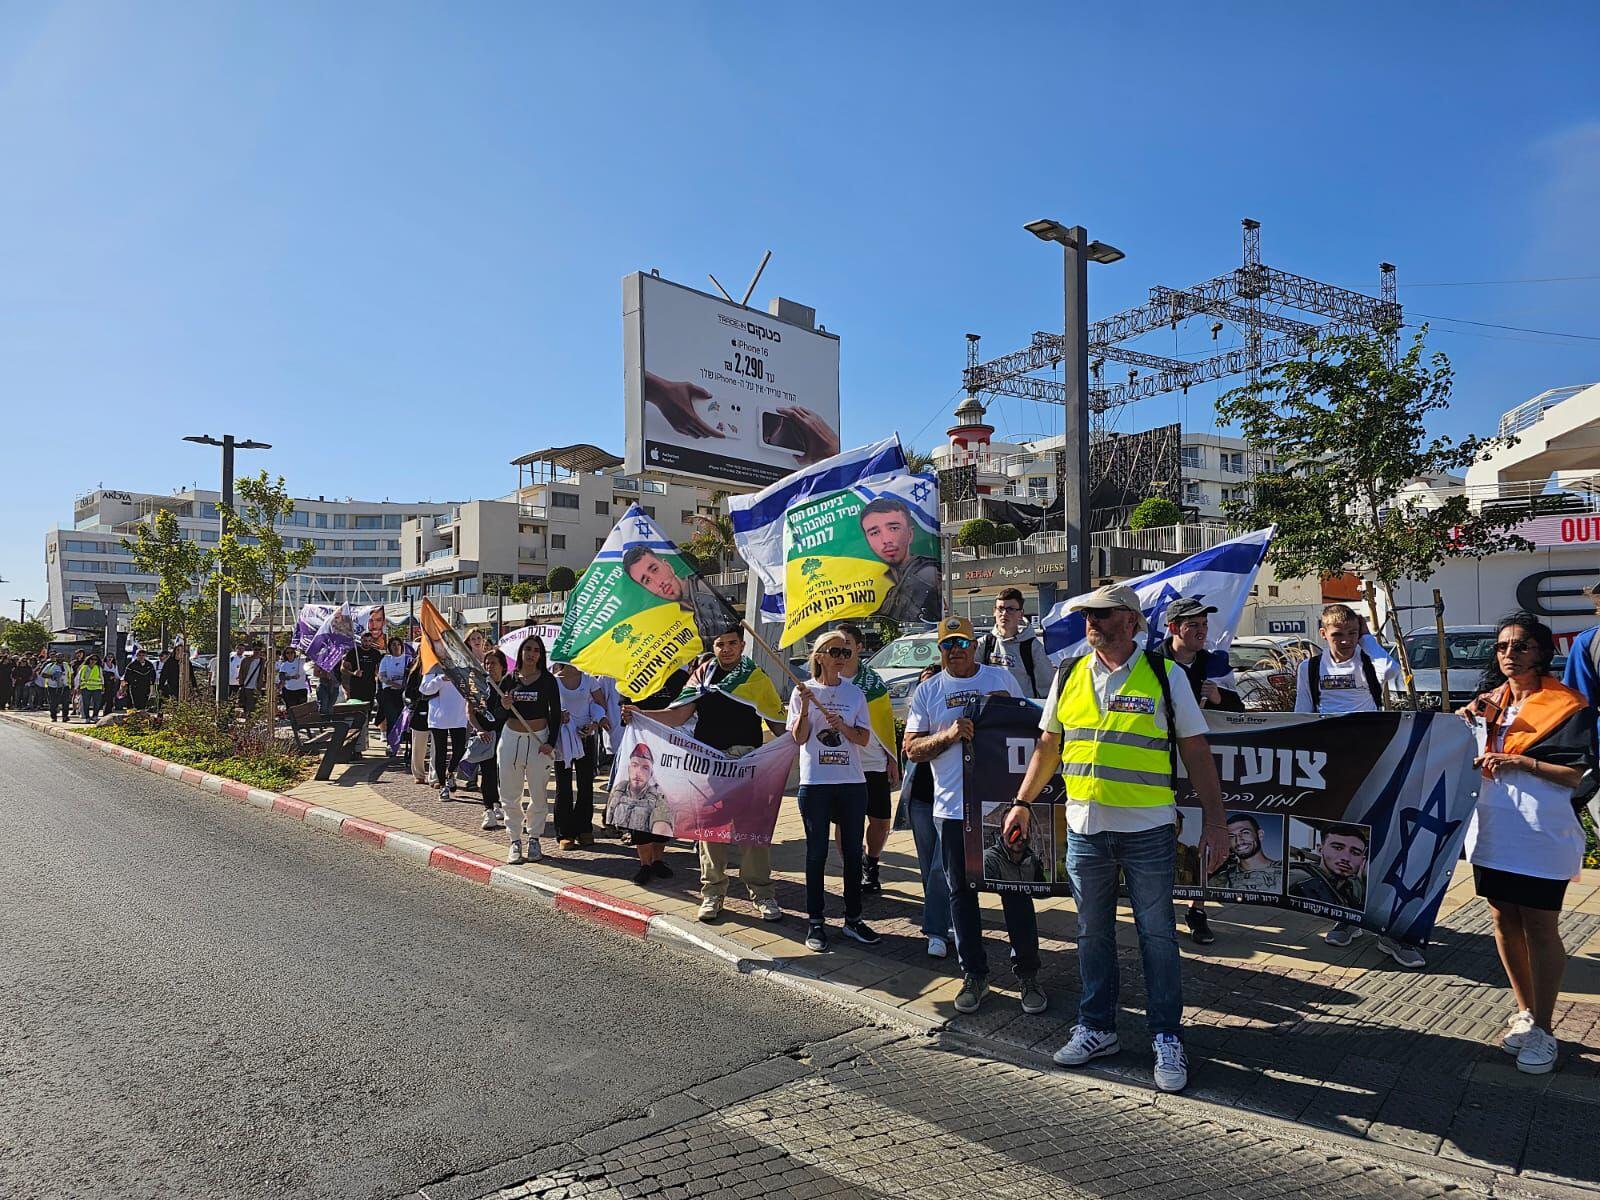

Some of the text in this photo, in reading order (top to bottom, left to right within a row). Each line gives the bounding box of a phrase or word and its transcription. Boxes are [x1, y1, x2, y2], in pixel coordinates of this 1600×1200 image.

[734, 352, 763, 380] 2,290
[102, 490, 132, 501] AKOYA
[808, 504, 819, 517] גם
[836, 504, 861, 519] יפריד
[803, 512, 836, 534] האהבה
[1037, 564, 1064, 574] GUESS
[839, 584, 852, 592] של
[825, 594, 845, 610] כהן
[850, 589, 876, 604] מאור
[528, 602, 566, 617] AMERICA
[674, 626, 696, 649] מאור
[661, 641, 681, 661] כהן
[627, 655, 667, 695] איזנקוט
[1177, 744, 1328, 790] צועד
[1256, 790, 1314, 810] למען
[1331, 908, 1343, 918] כהן
[1344, 912, 1362, 922] מאור
